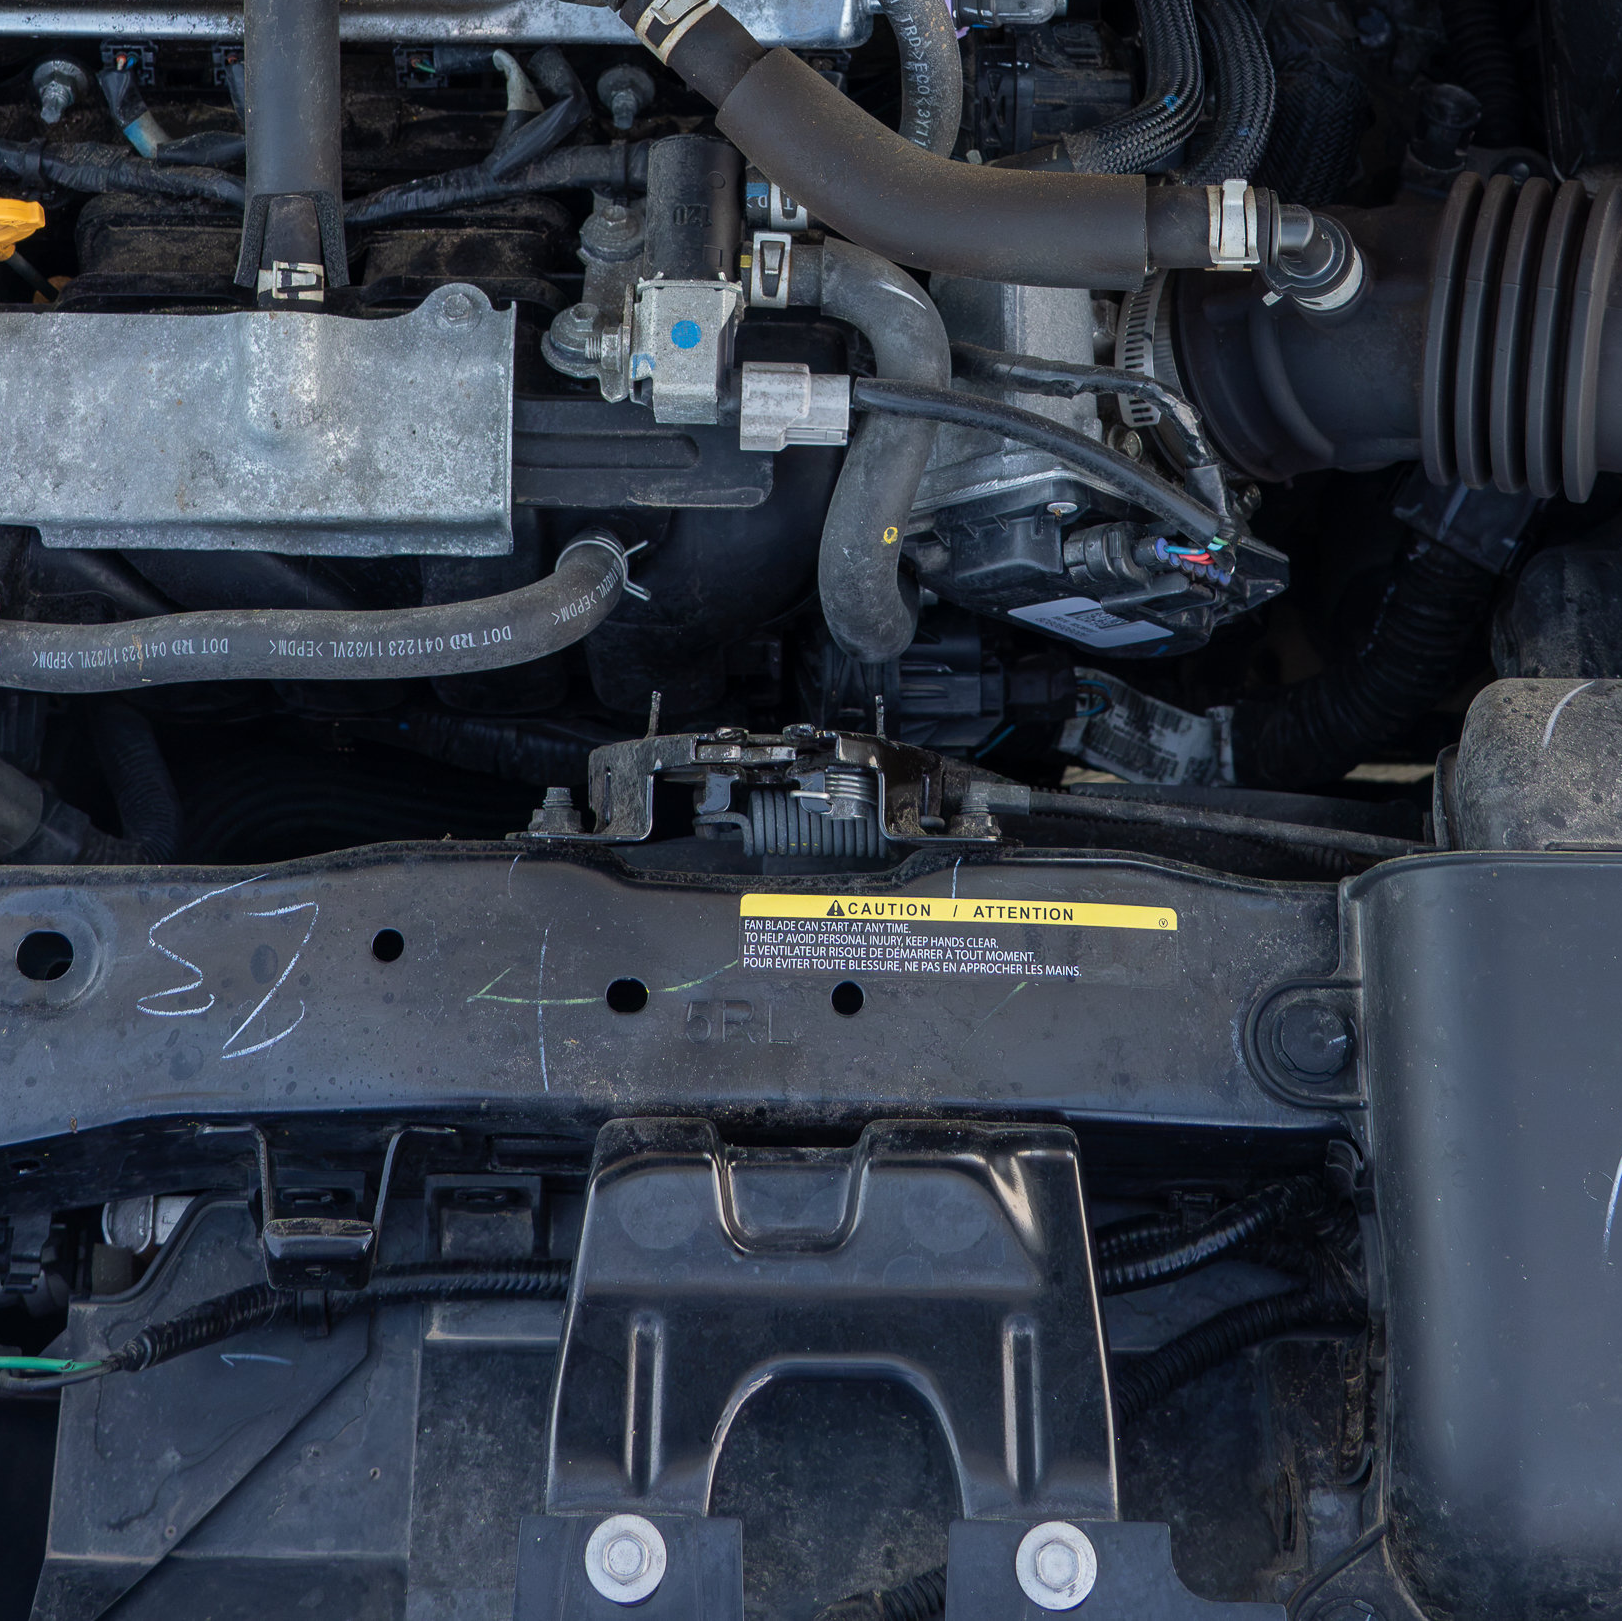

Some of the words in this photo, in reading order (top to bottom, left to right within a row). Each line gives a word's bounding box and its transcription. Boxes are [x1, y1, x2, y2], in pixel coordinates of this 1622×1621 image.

[482, 625, 512, 646] DOT
[200, 638, 228, 654] DOT
[388, 637, 444, 657] 041223
[848, 903, 931, 917] CAUTION
[973, 905, 1074, 921] ATTENTION
[745, 920, 763, 930] FAN
[766, 921, 796, 931] BLADE
[798, 921, 819, 931] CAN
[821, 922, 849, 932] START
[851, 923, 863, 932] AT
[865, 923, 886, 932] ANY
[886, 923, 911, 933] TIME.
[745, 932, 758, 942] TO
[760, 933, 783, 943] HELP
[786, 934, 815, 944] AVOID
[818, 934, 867, 945] PERSONAL
[870, 936, 903, 947] INJURY,
[906, 937, 928, 946] KEEP
[931, 937, 964, 947] HANDS
[967, 938, 999, 949] CLEAR.
[744, 945, 755, 954] LE
[757, 945, 826, 957] VENTILATEUR
[829, 947, 867, 959] RISQUE
[869, 948, 883, 957] DE
[886, 945, 943, 959] DÉMARRER
[946, 947, 953, 960] À
[957, 950, 983, 961] TOUT
[986, 951, 1036, 962] MOMENT.
[744, 958, 773, 968] POUR
[776, 956, 810, 969] ÉVITER
[812, 959, 846, 969] TOUTE
[849, 959, 902, 972] BLESSURE,
[905, 961, 918, 971] NE
[921, 962, 940, 972] PAS
[943, 963, 957, 973] EN
[959, 962, 1023, 974] APPROCHER
[1025, 964, 1043, 975] LES
[1046, 965, 1082, 977] MAINS.
